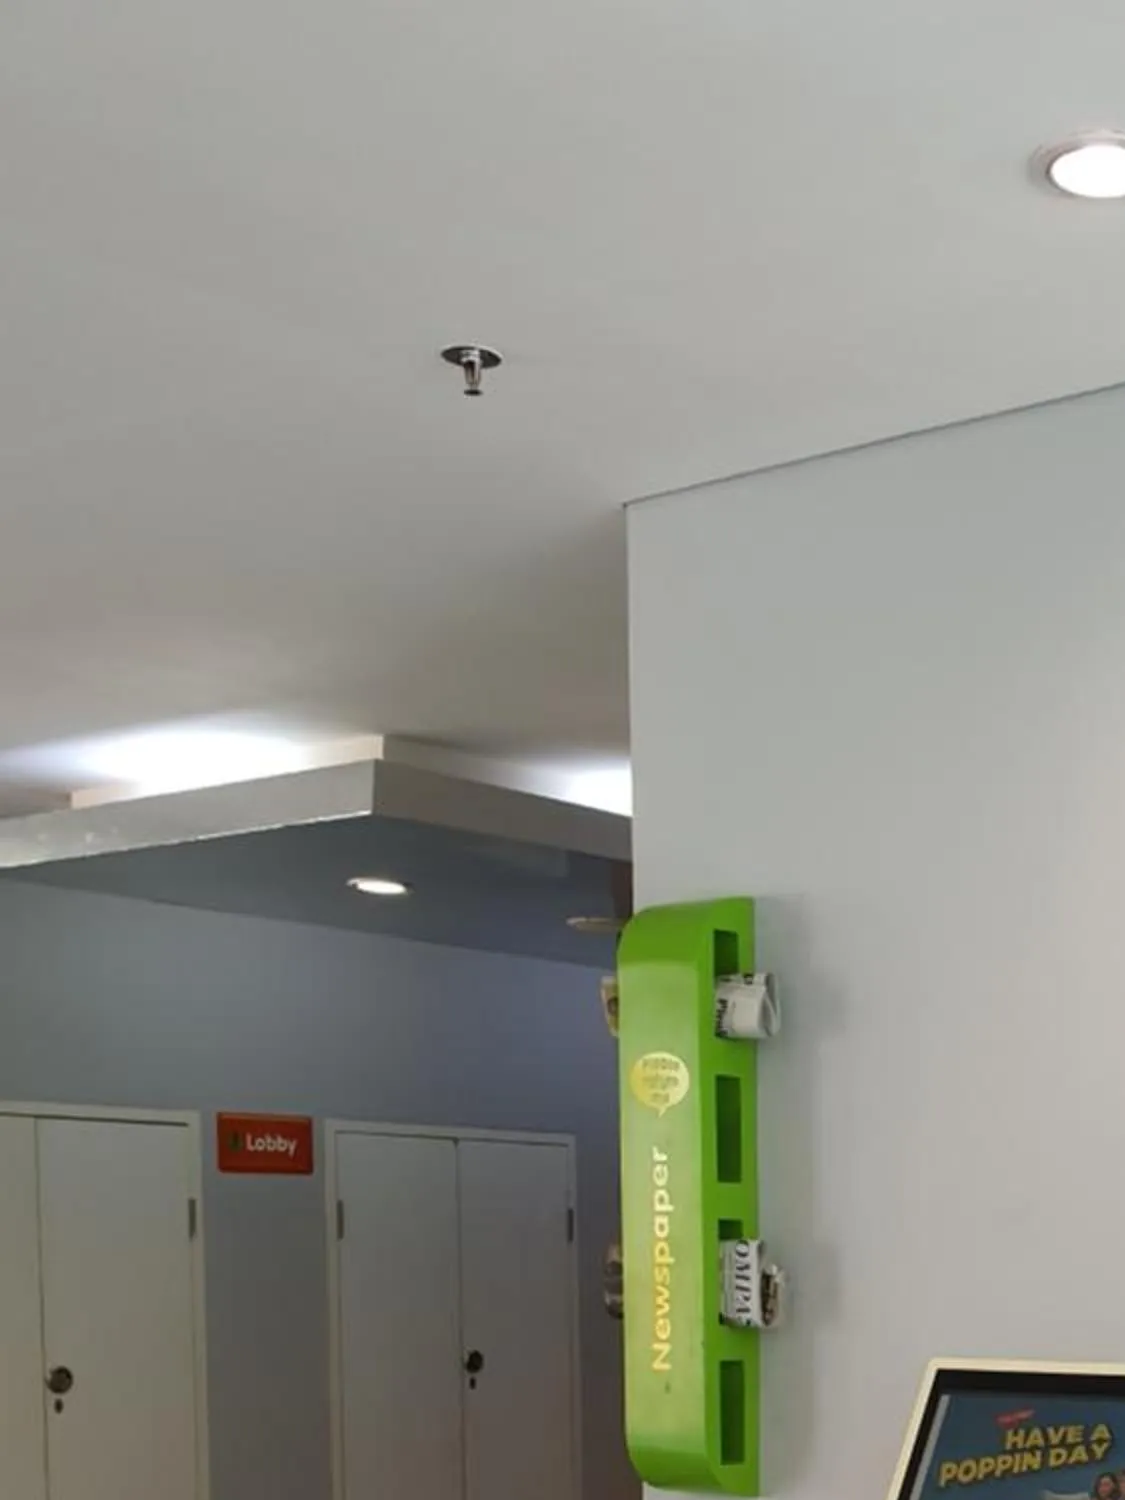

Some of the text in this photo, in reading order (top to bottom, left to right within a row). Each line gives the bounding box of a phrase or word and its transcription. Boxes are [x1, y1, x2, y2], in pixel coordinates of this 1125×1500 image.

[245, 1132, 297, 1158] Lobby
[652, 1146, 674, 1371] Newspaper
[1005, 1423, 1111, 1450] HAVE A
[939, 1440, 1111, 1488] POPPIN DAY
